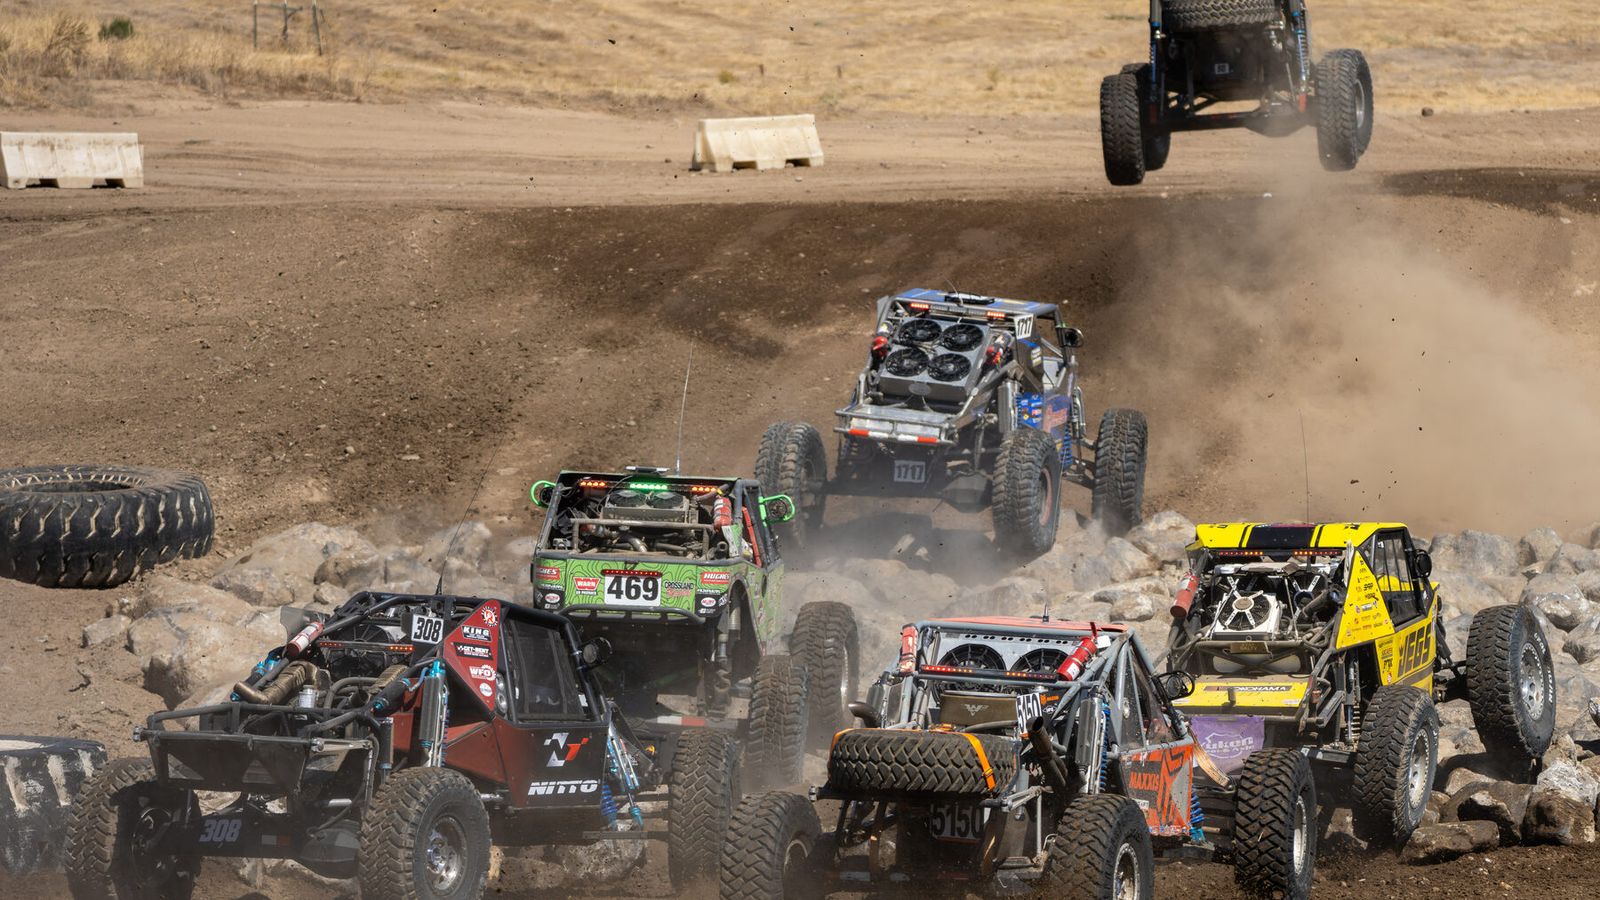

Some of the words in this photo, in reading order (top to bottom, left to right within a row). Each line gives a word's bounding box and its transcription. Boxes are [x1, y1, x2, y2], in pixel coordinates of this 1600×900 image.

[1017, 316, 1033, 337] 1717
[896, 464, 924, 480] 1717
[606, 576, 659, 601] 469
[664, 581, 694, 590] CROSSLAND
[413, 618, 442, 643] 308
[463, 626, 490, 637] KING
[470, 668, 492, 678] WFO
[527, 779, 599, 796] NITTO
[1128, 771, 1160, 792] MAXXIS
[199, 818, 243, 843] 308
